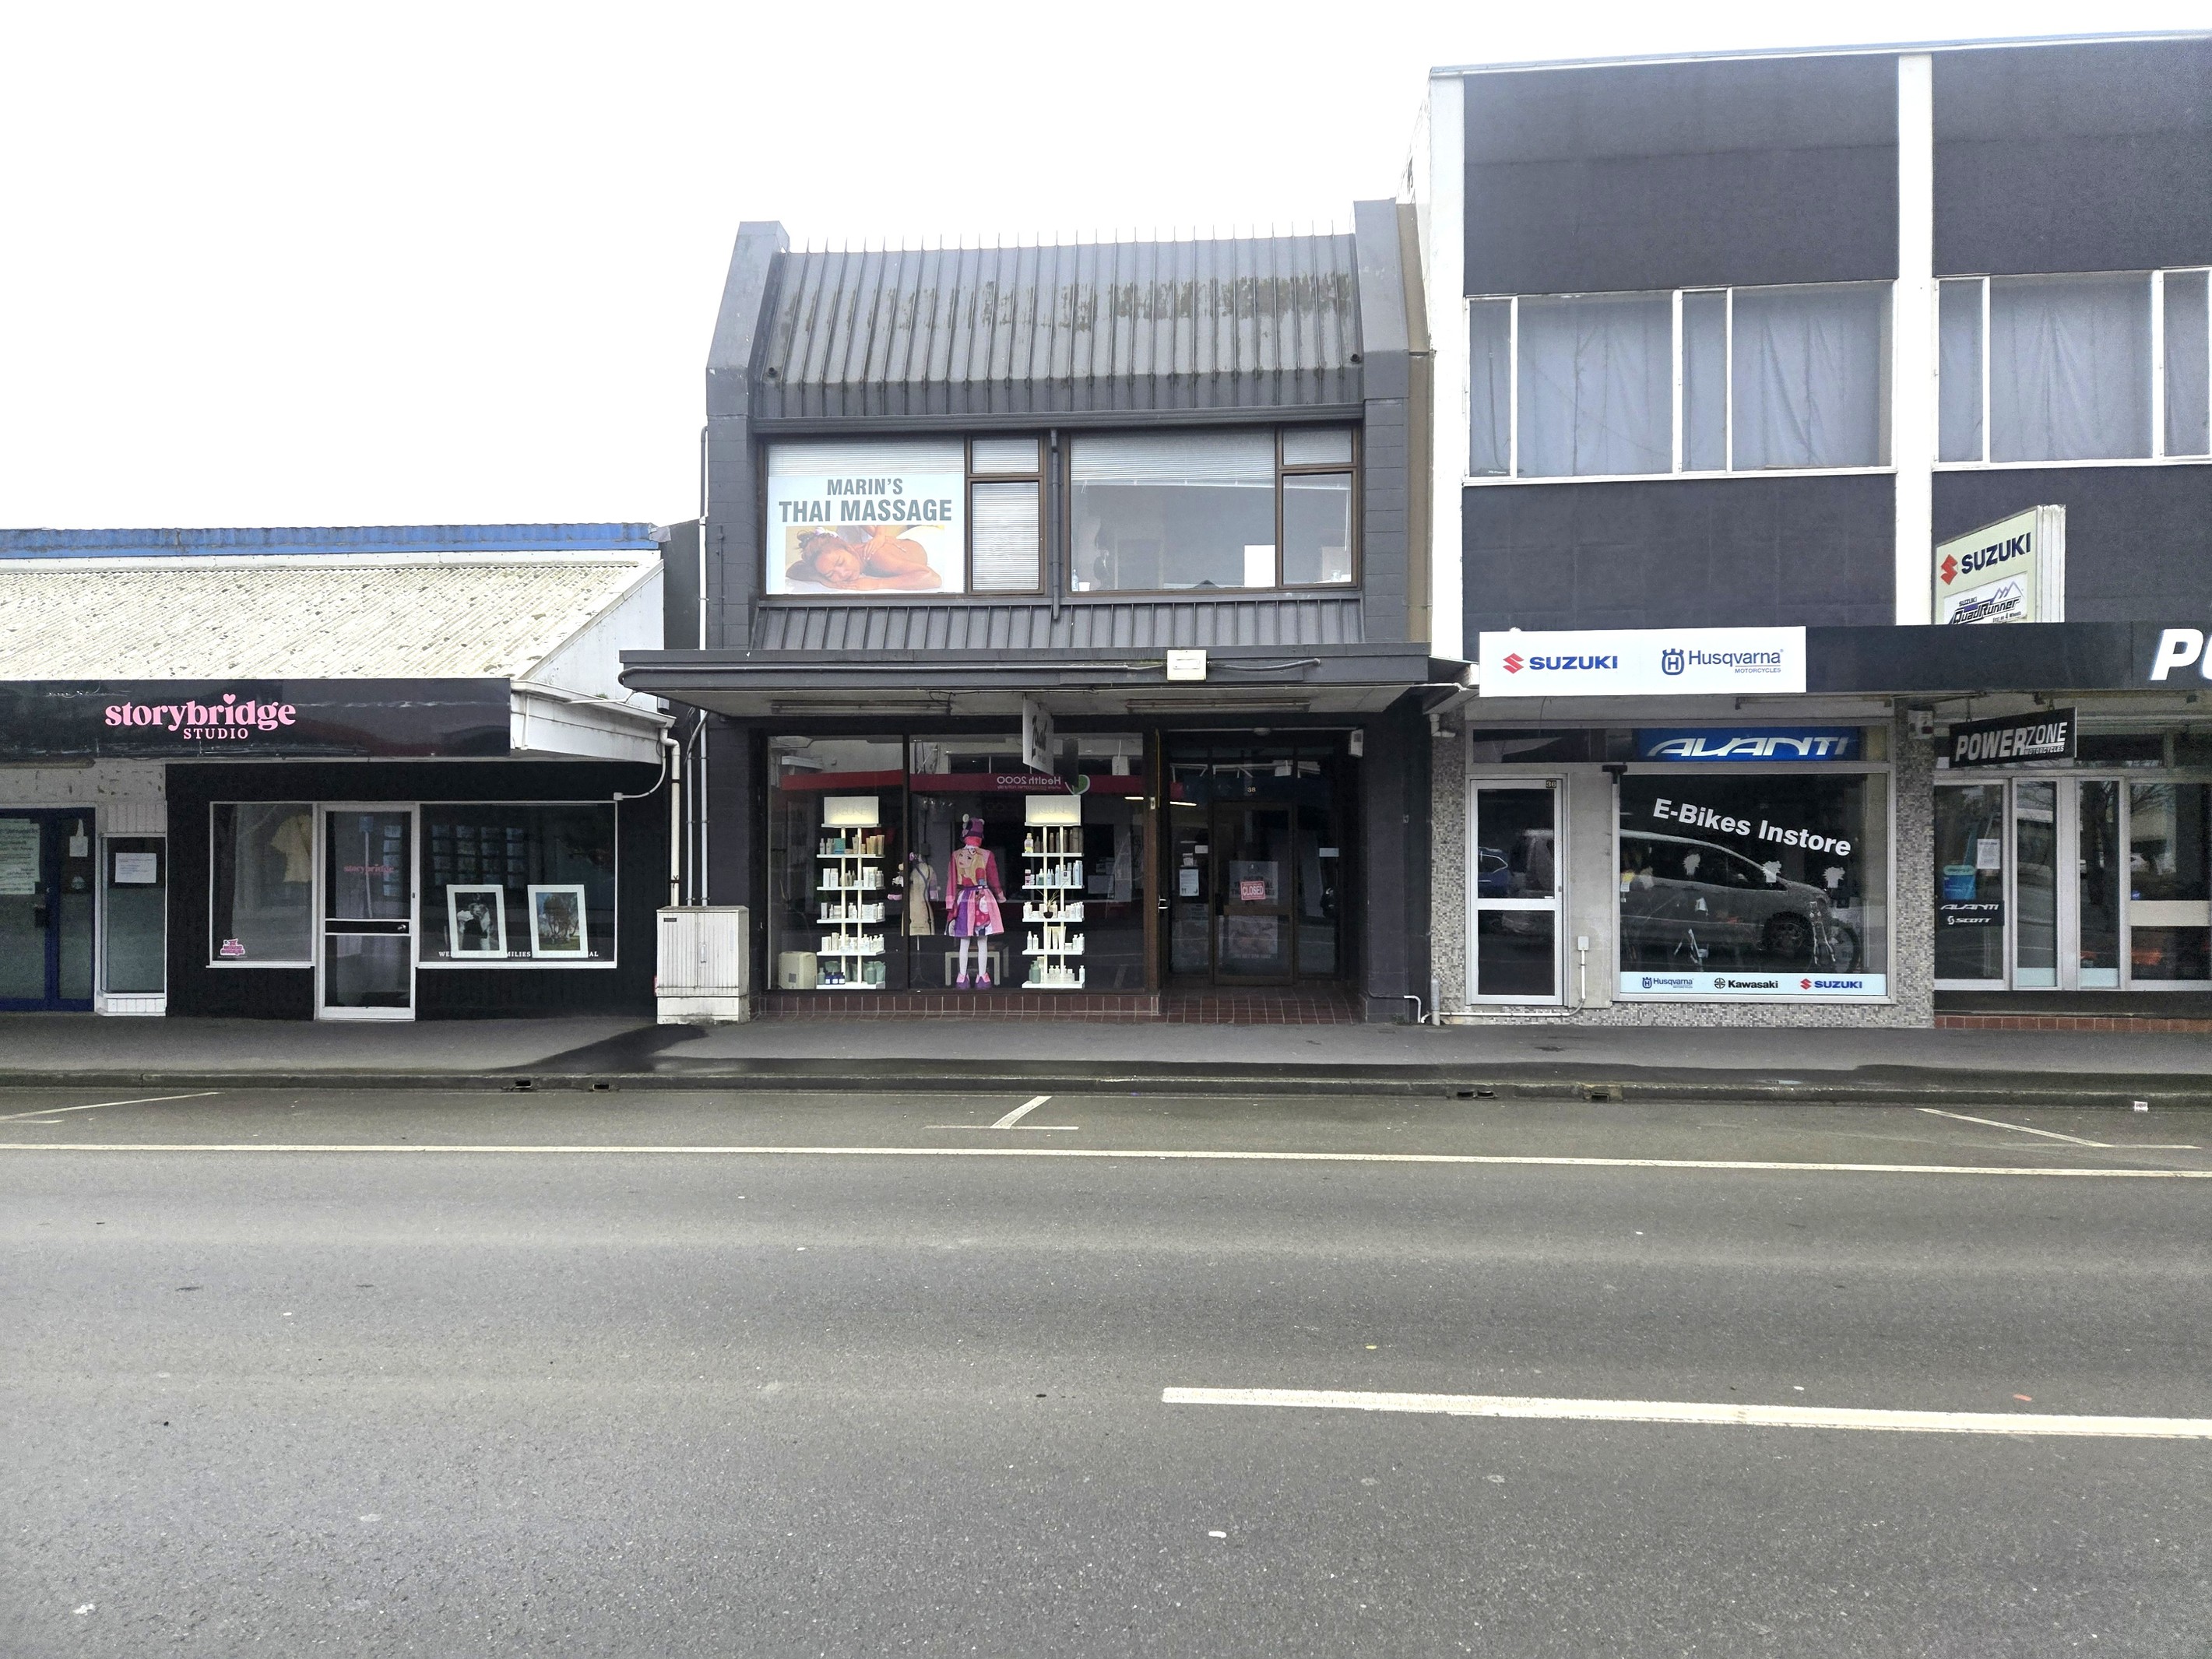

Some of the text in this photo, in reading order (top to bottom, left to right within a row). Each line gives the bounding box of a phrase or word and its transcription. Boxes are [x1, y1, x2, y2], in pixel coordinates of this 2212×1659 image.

[827, 478, 903, 496] MARIN'S
[779, 498, 952, 522] THAI MASSAGE
[1961, 532, 2031, 575] SUZUKI
[1959, 596, 1978, 606] SUZUKI
[1529, 656, 1619, 670] SUZUKI
[1689, 650, 1781, 666] Husqvarna
[104, 693, 297, 732] storybridge
[183, 728, 249, 740] STUDIO
[1647, 736, 1849, 757] AVANTI
[2024, 745, 2065, 755] MOTORCYCLES
[1652, 798, 1852, 856] E-Bikes Instore
[1242, 886, 1264, 895] CLOSED
[1653, 978, 1693, 986] Husqvarna
[1728, 979, 1778, 989] Kawasaki
[1814, 980, 1862, 989] SUZUKI
